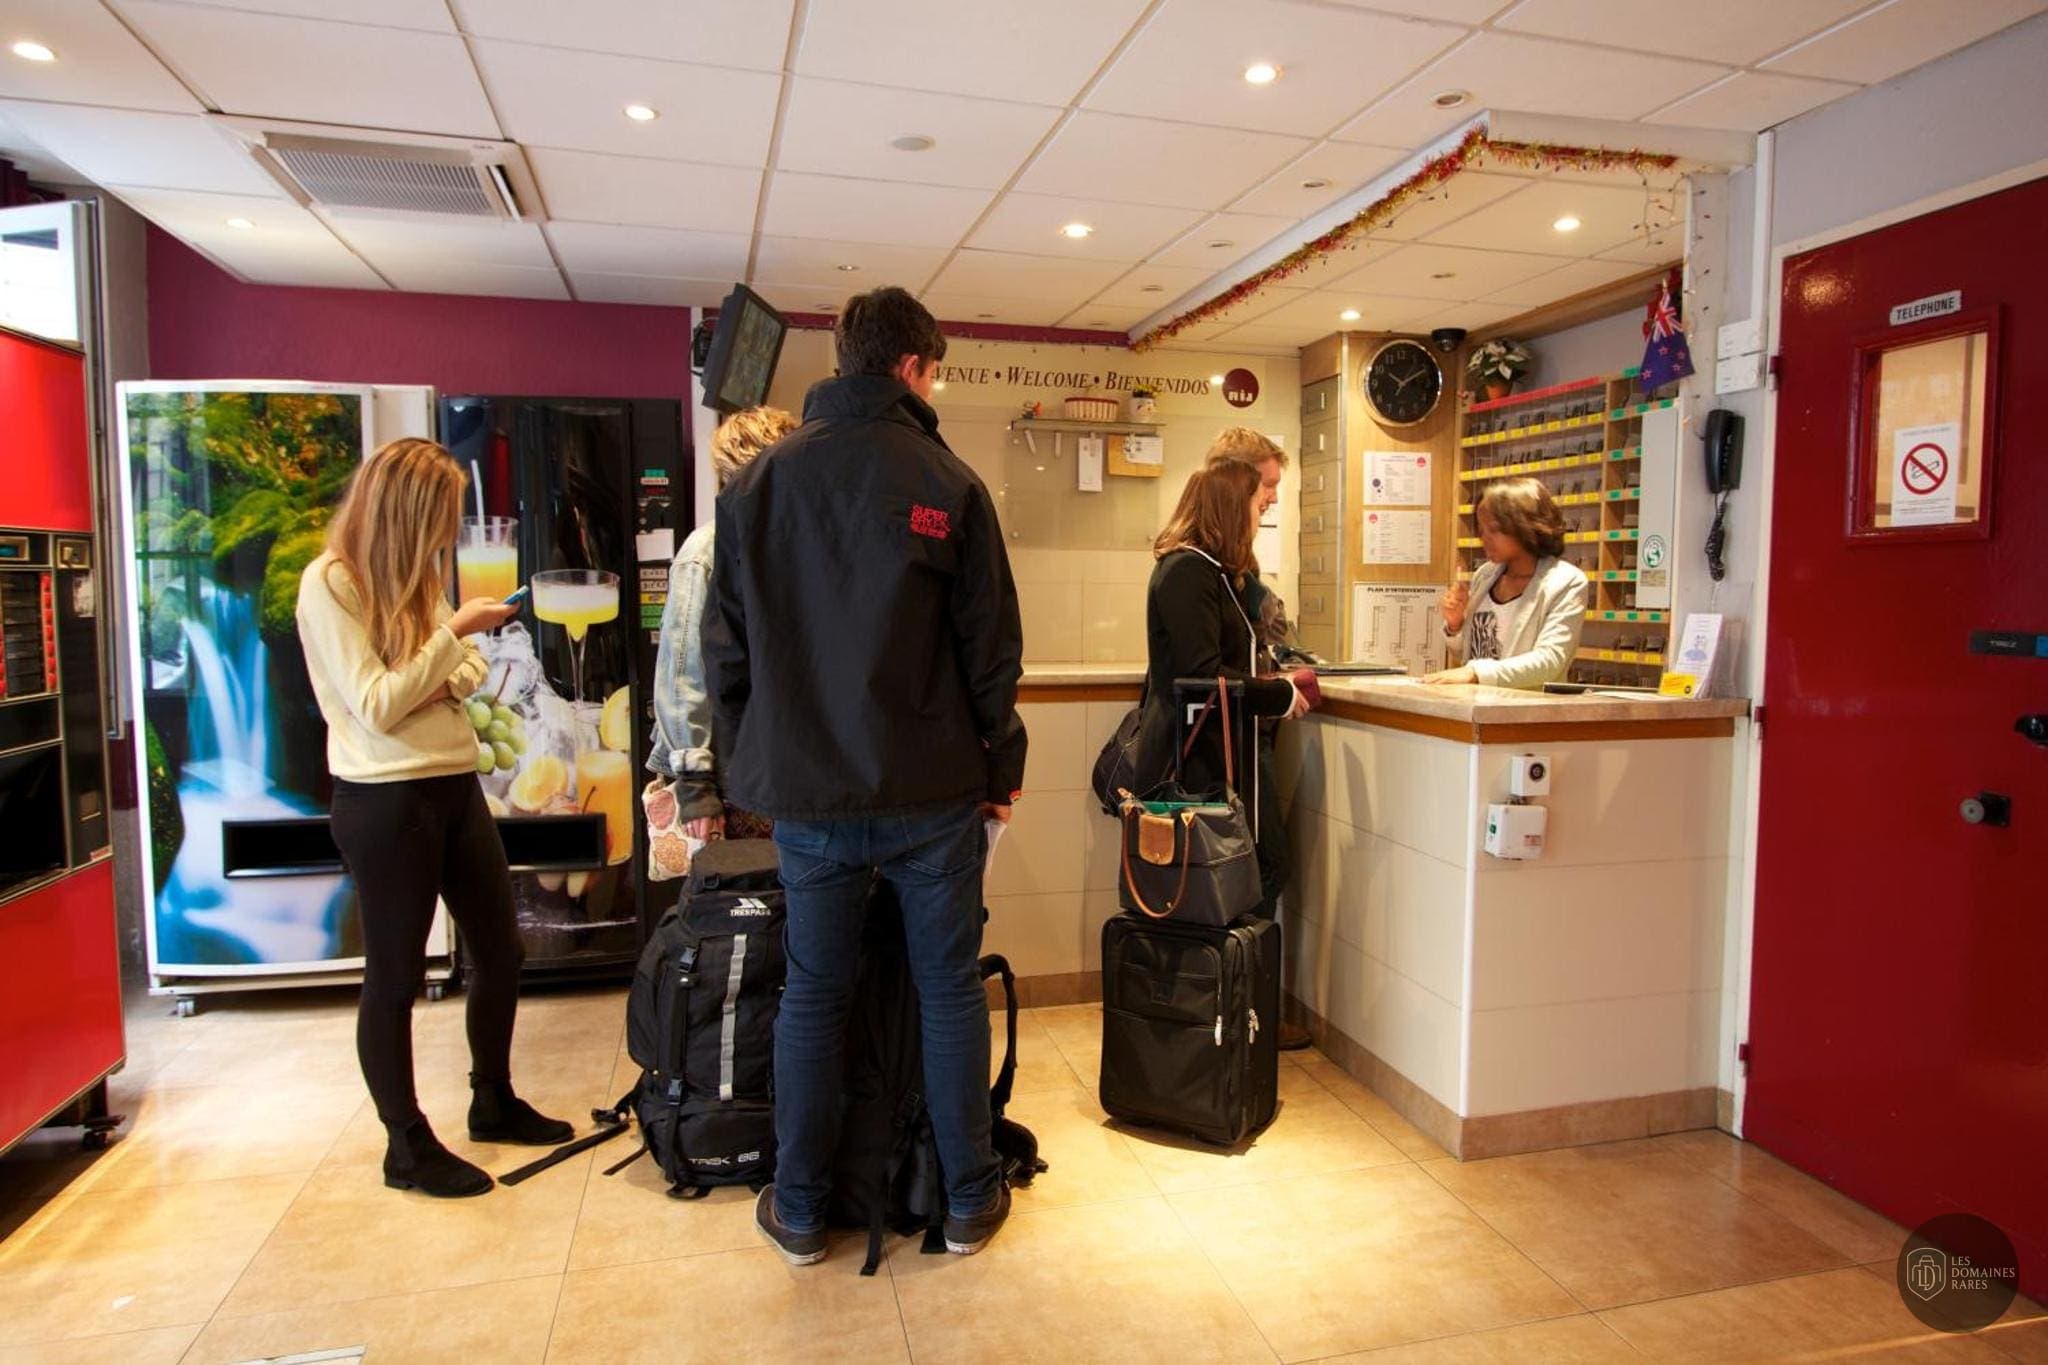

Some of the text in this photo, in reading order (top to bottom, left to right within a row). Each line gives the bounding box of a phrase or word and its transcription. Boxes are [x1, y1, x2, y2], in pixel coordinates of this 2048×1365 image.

[1896, 296, 1955, 321] TELEPHONE
[935, 365, 1210, 395] VENUE WELCOME BIENVENIDOS
